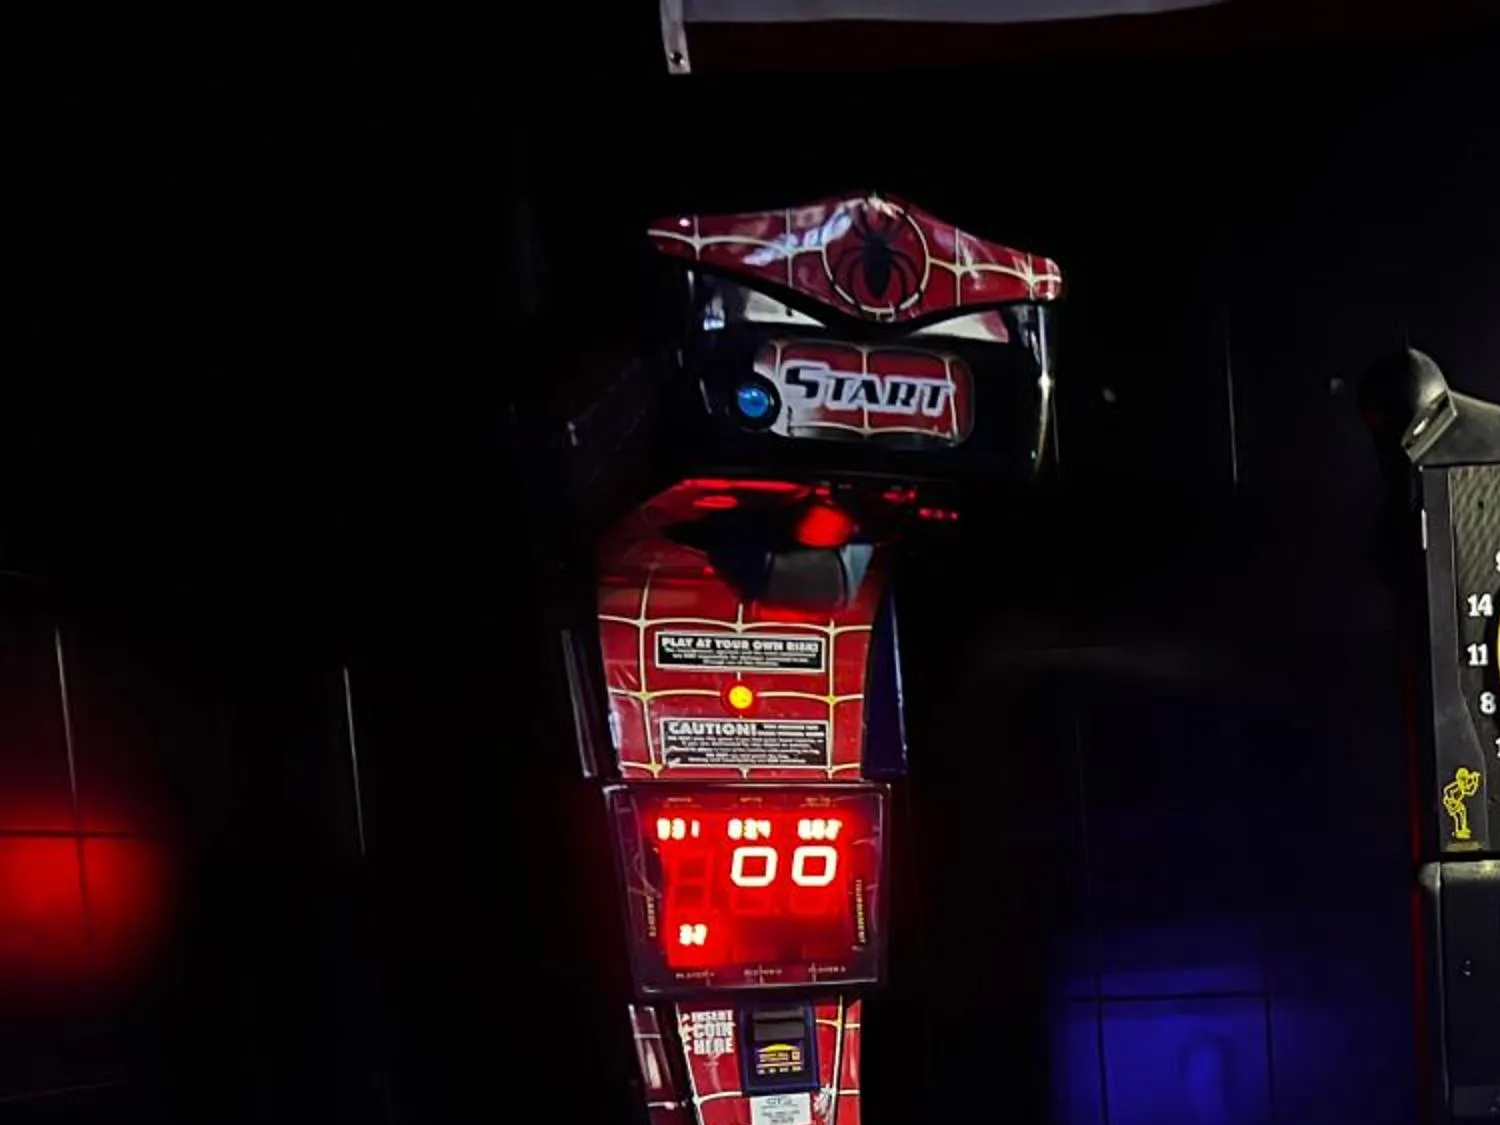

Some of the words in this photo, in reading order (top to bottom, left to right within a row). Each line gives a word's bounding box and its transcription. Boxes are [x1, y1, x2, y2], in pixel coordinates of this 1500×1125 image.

[784, 364, 953, 412] START
[1467, 593, 1493, 617] 14
[660, 637, 694, 648] PLAY
[696, 638, 712, 649] AT
[714, 639, 749, 650] YOUR
[752, 641, 784, 651] OWN
[1467, 643, 1488, 666] 11
[1480, 691, 1496, 714] 8
[667, 721, 757, 737] CAUTION!
[691, 1009, 734, 1023] INSERT
[693, 1022, 736, 1039] COIN
[693, 1037, 735, 1055] HERE
